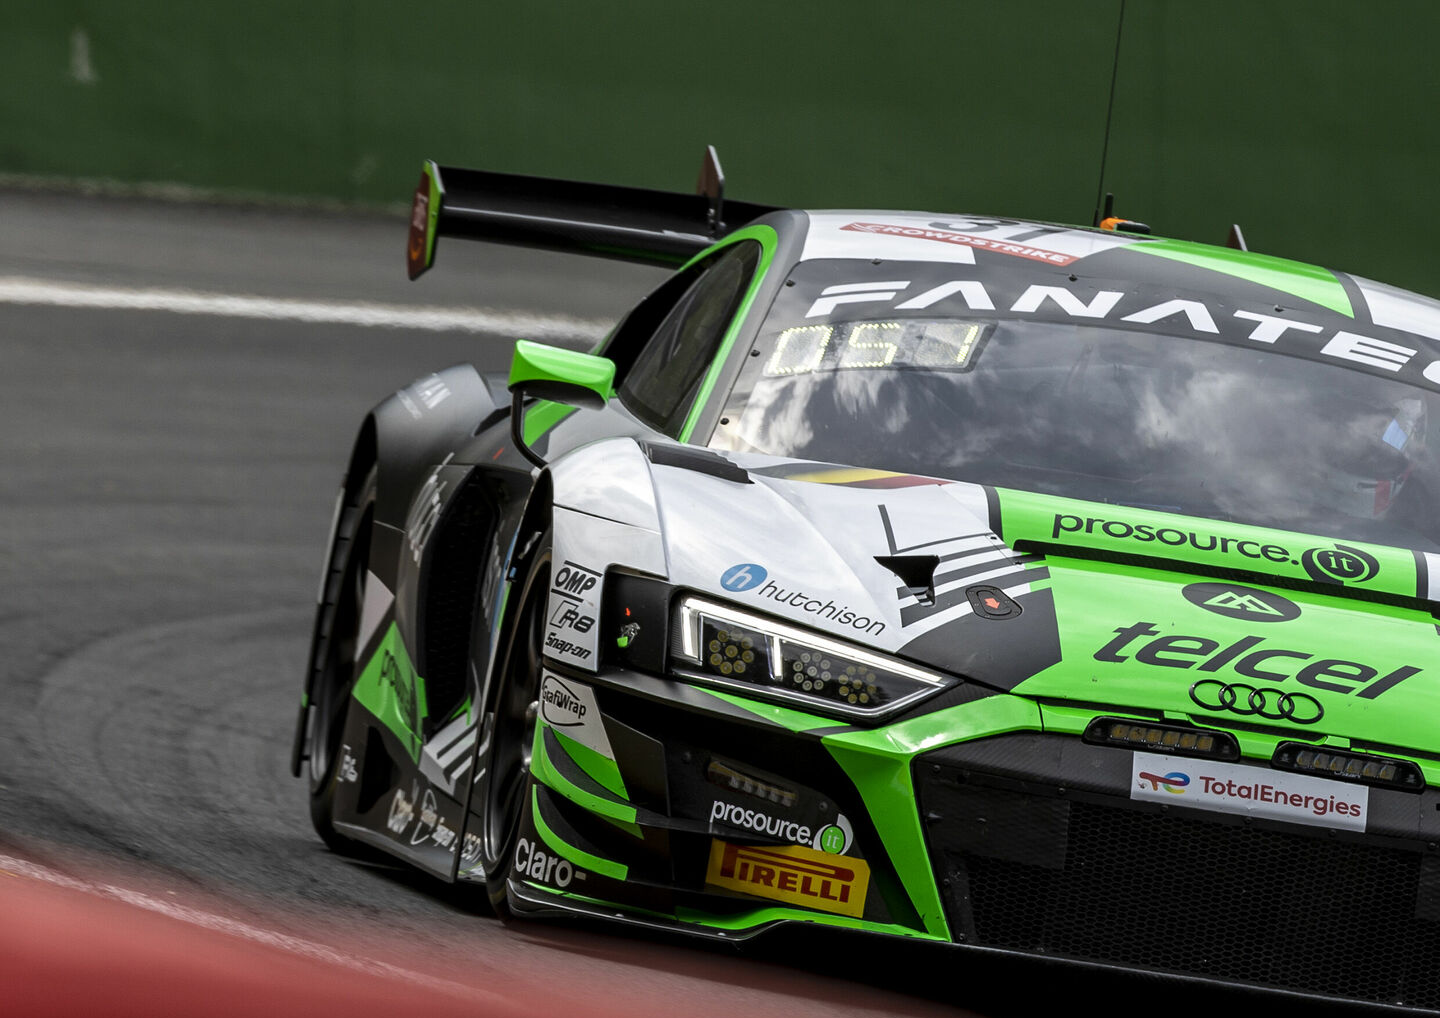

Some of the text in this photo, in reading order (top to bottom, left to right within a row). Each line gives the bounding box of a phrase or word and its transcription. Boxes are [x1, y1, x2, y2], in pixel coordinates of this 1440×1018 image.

[864, 224, 1070, 263] CROWDSTRIKE
[554, 566, 597, 596] OMP
[758, 580, 886, 636] hutchison
[545, 632, 592, 660] Snap-on
[1093, 621, 1423, 699] telcel
[542, 685, 587, 719] GrafiWrap
[1200, 776, 1361, 818] TotalEnergies
[720, 842, 855, 903] PIRELLI
